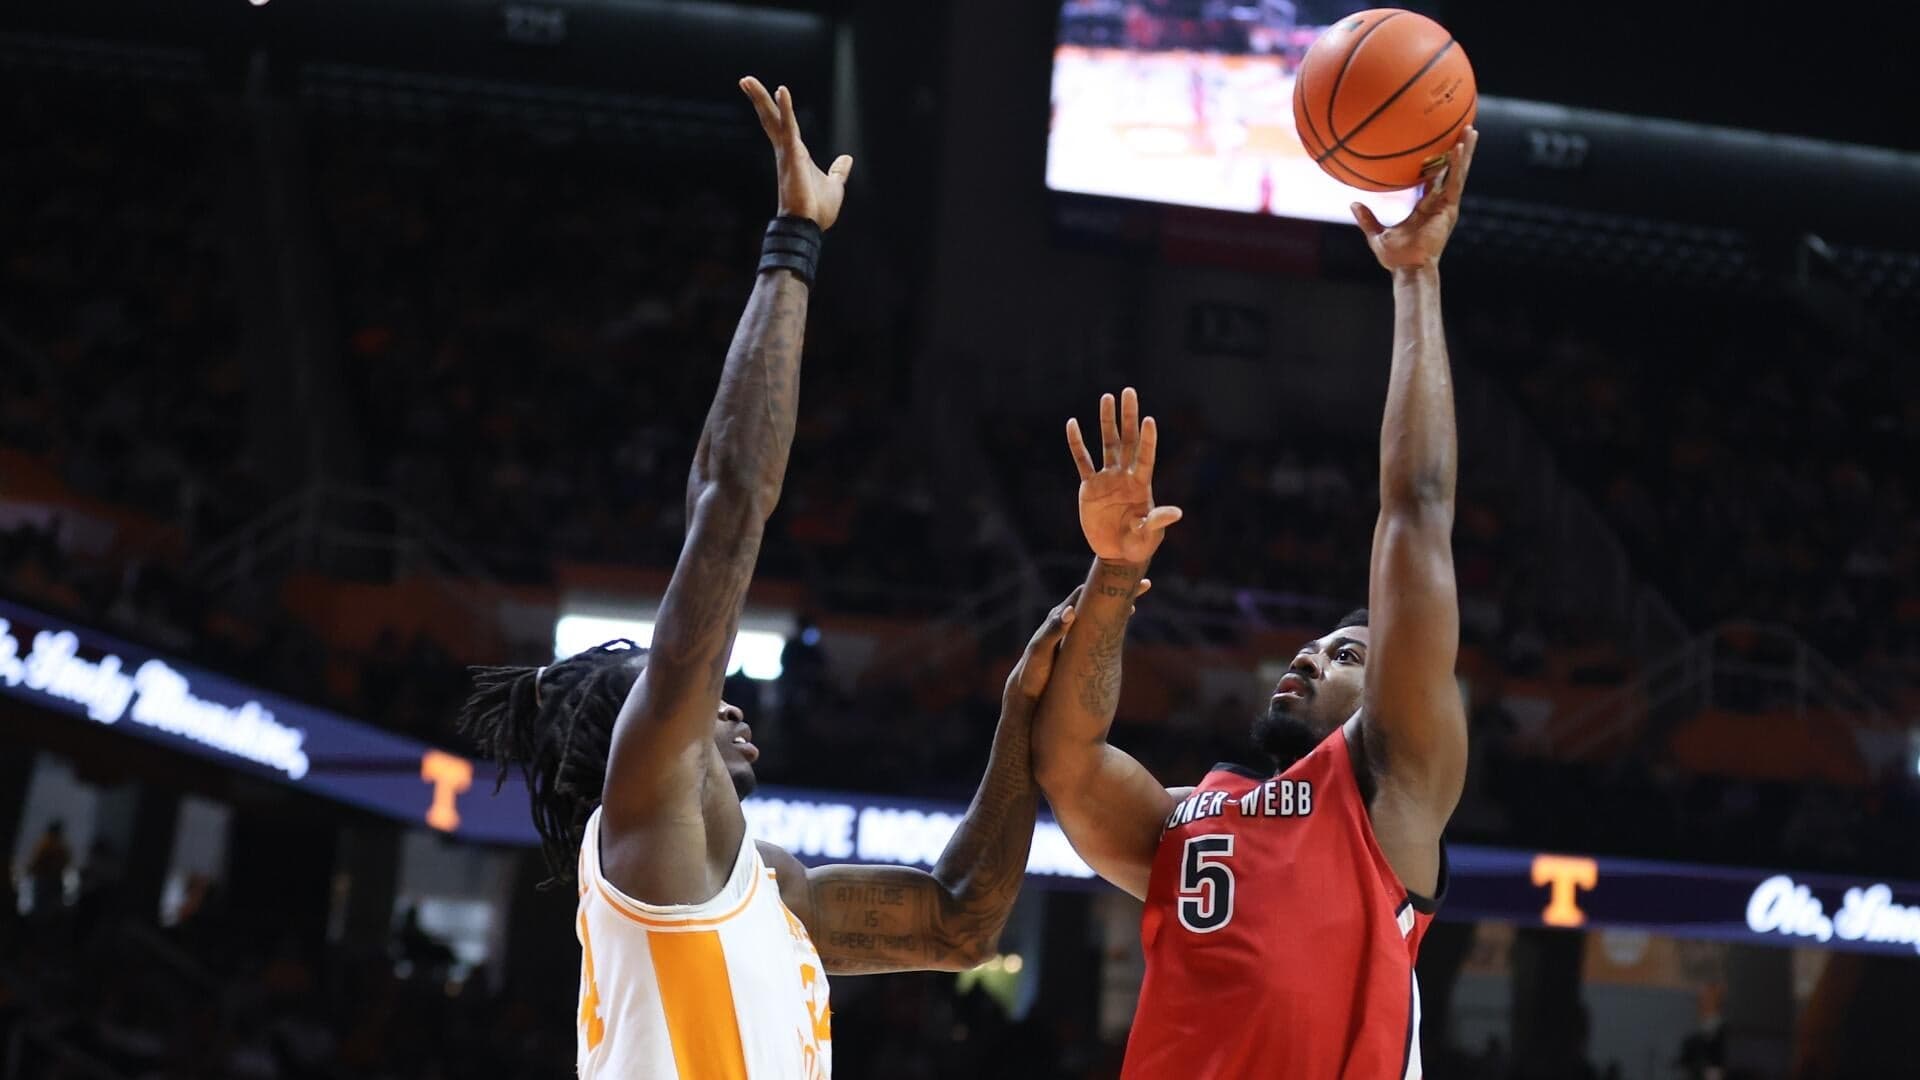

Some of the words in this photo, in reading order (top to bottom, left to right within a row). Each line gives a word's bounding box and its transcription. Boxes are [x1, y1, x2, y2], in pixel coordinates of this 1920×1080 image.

[421, 748, 474, 833] T
[1164, 779, 1313, 832] DNER-WEBB
[1178, 833, 1236, 934] 5
[1530, 853, 1599, 928] T
